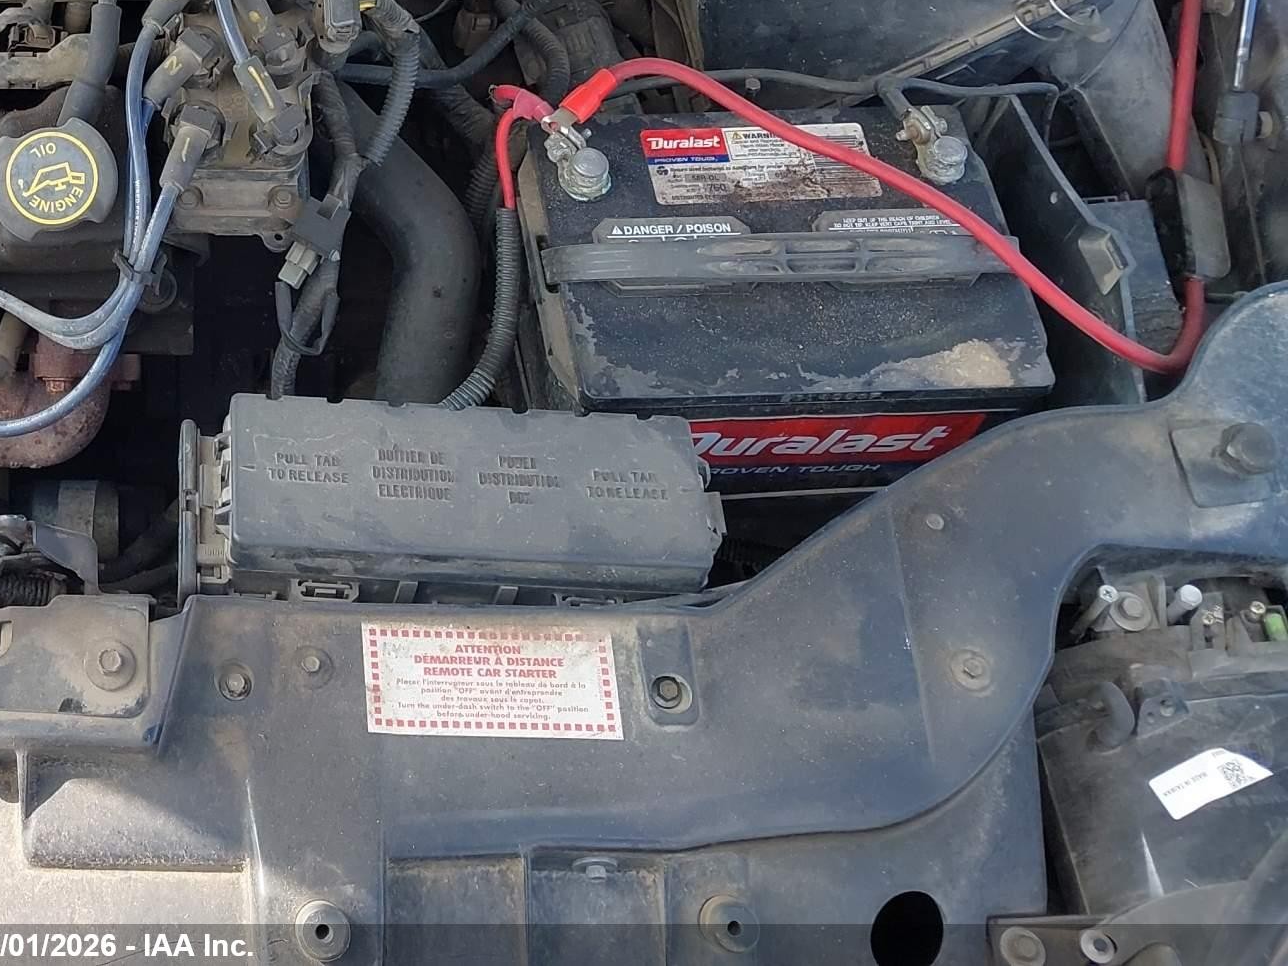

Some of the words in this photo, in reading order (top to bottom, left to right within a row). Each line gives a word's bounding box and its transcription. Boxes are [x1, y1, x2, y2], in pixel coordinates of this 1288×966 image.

[647, 136, 721, 150] Duralast
[30, 142, 56, 160] OIL
[28, 186, 84, 213] ENGINE
[623, 225, 673, 235] DANGER
[676, 224, 683, 233] /
[686, 223, 731, 233] POISON
[275, 451, 308, 465] PULL
[314, 454, 340, 467] TAB
[268, 467, 285, 481] TO
[288, 469, 350, 484] RELEASE
[371, 465, 456, 483] DISTRIBUTION
[592, 469, 627, 483] PULL
[709, 465, 789, 475] ROVEN
[798, 464, 881, 473] TOUGH
[585, 485, 605, 499] TO
[606, 487, 669, 501] RELEASE
[455, 644, 521, 655] ATTENTION
[414, 652, 490, 665] DÉMARREUR
[494, 655, 503, 666] À
[506, 657, 565, 667] DISTANCE
[423, 667, 473, 677] REMOTE
[477, 668, 501, 677] CAR
[505, 669, 558, 679] STARTER
[422, 679, 473, 688] l'interrupteur
[505, 689, 563, 697] d'entreprendre
[464, 711, 511, 719] under-hood
[514, 713, 551, 721] servicing.
[557, 705, 589, 715] position
